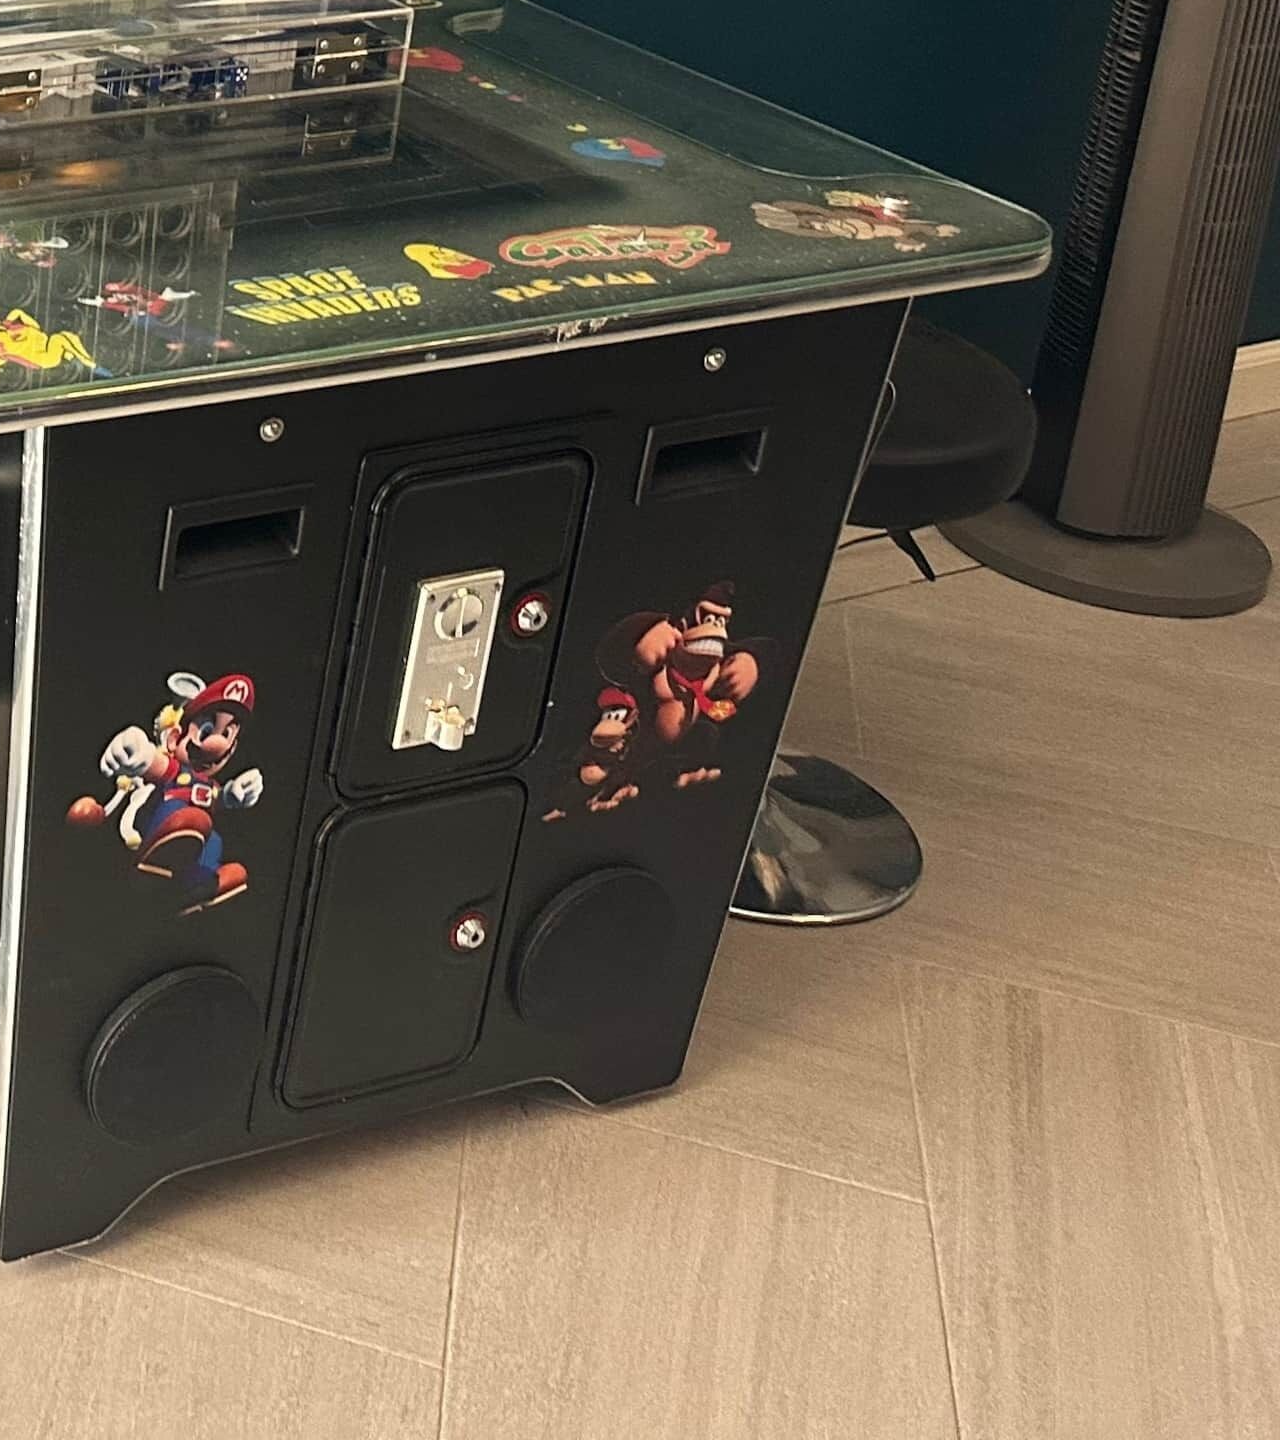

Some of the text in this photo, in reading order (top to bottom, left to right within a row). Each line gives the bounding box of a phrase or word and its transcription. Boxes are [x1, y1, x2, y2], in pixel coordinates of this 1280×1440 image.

[233, 266, 367, 302] SPACE
[493, 271, 659, 303] PAC-MAN
[227, 283, 422, 326] INVADERS
